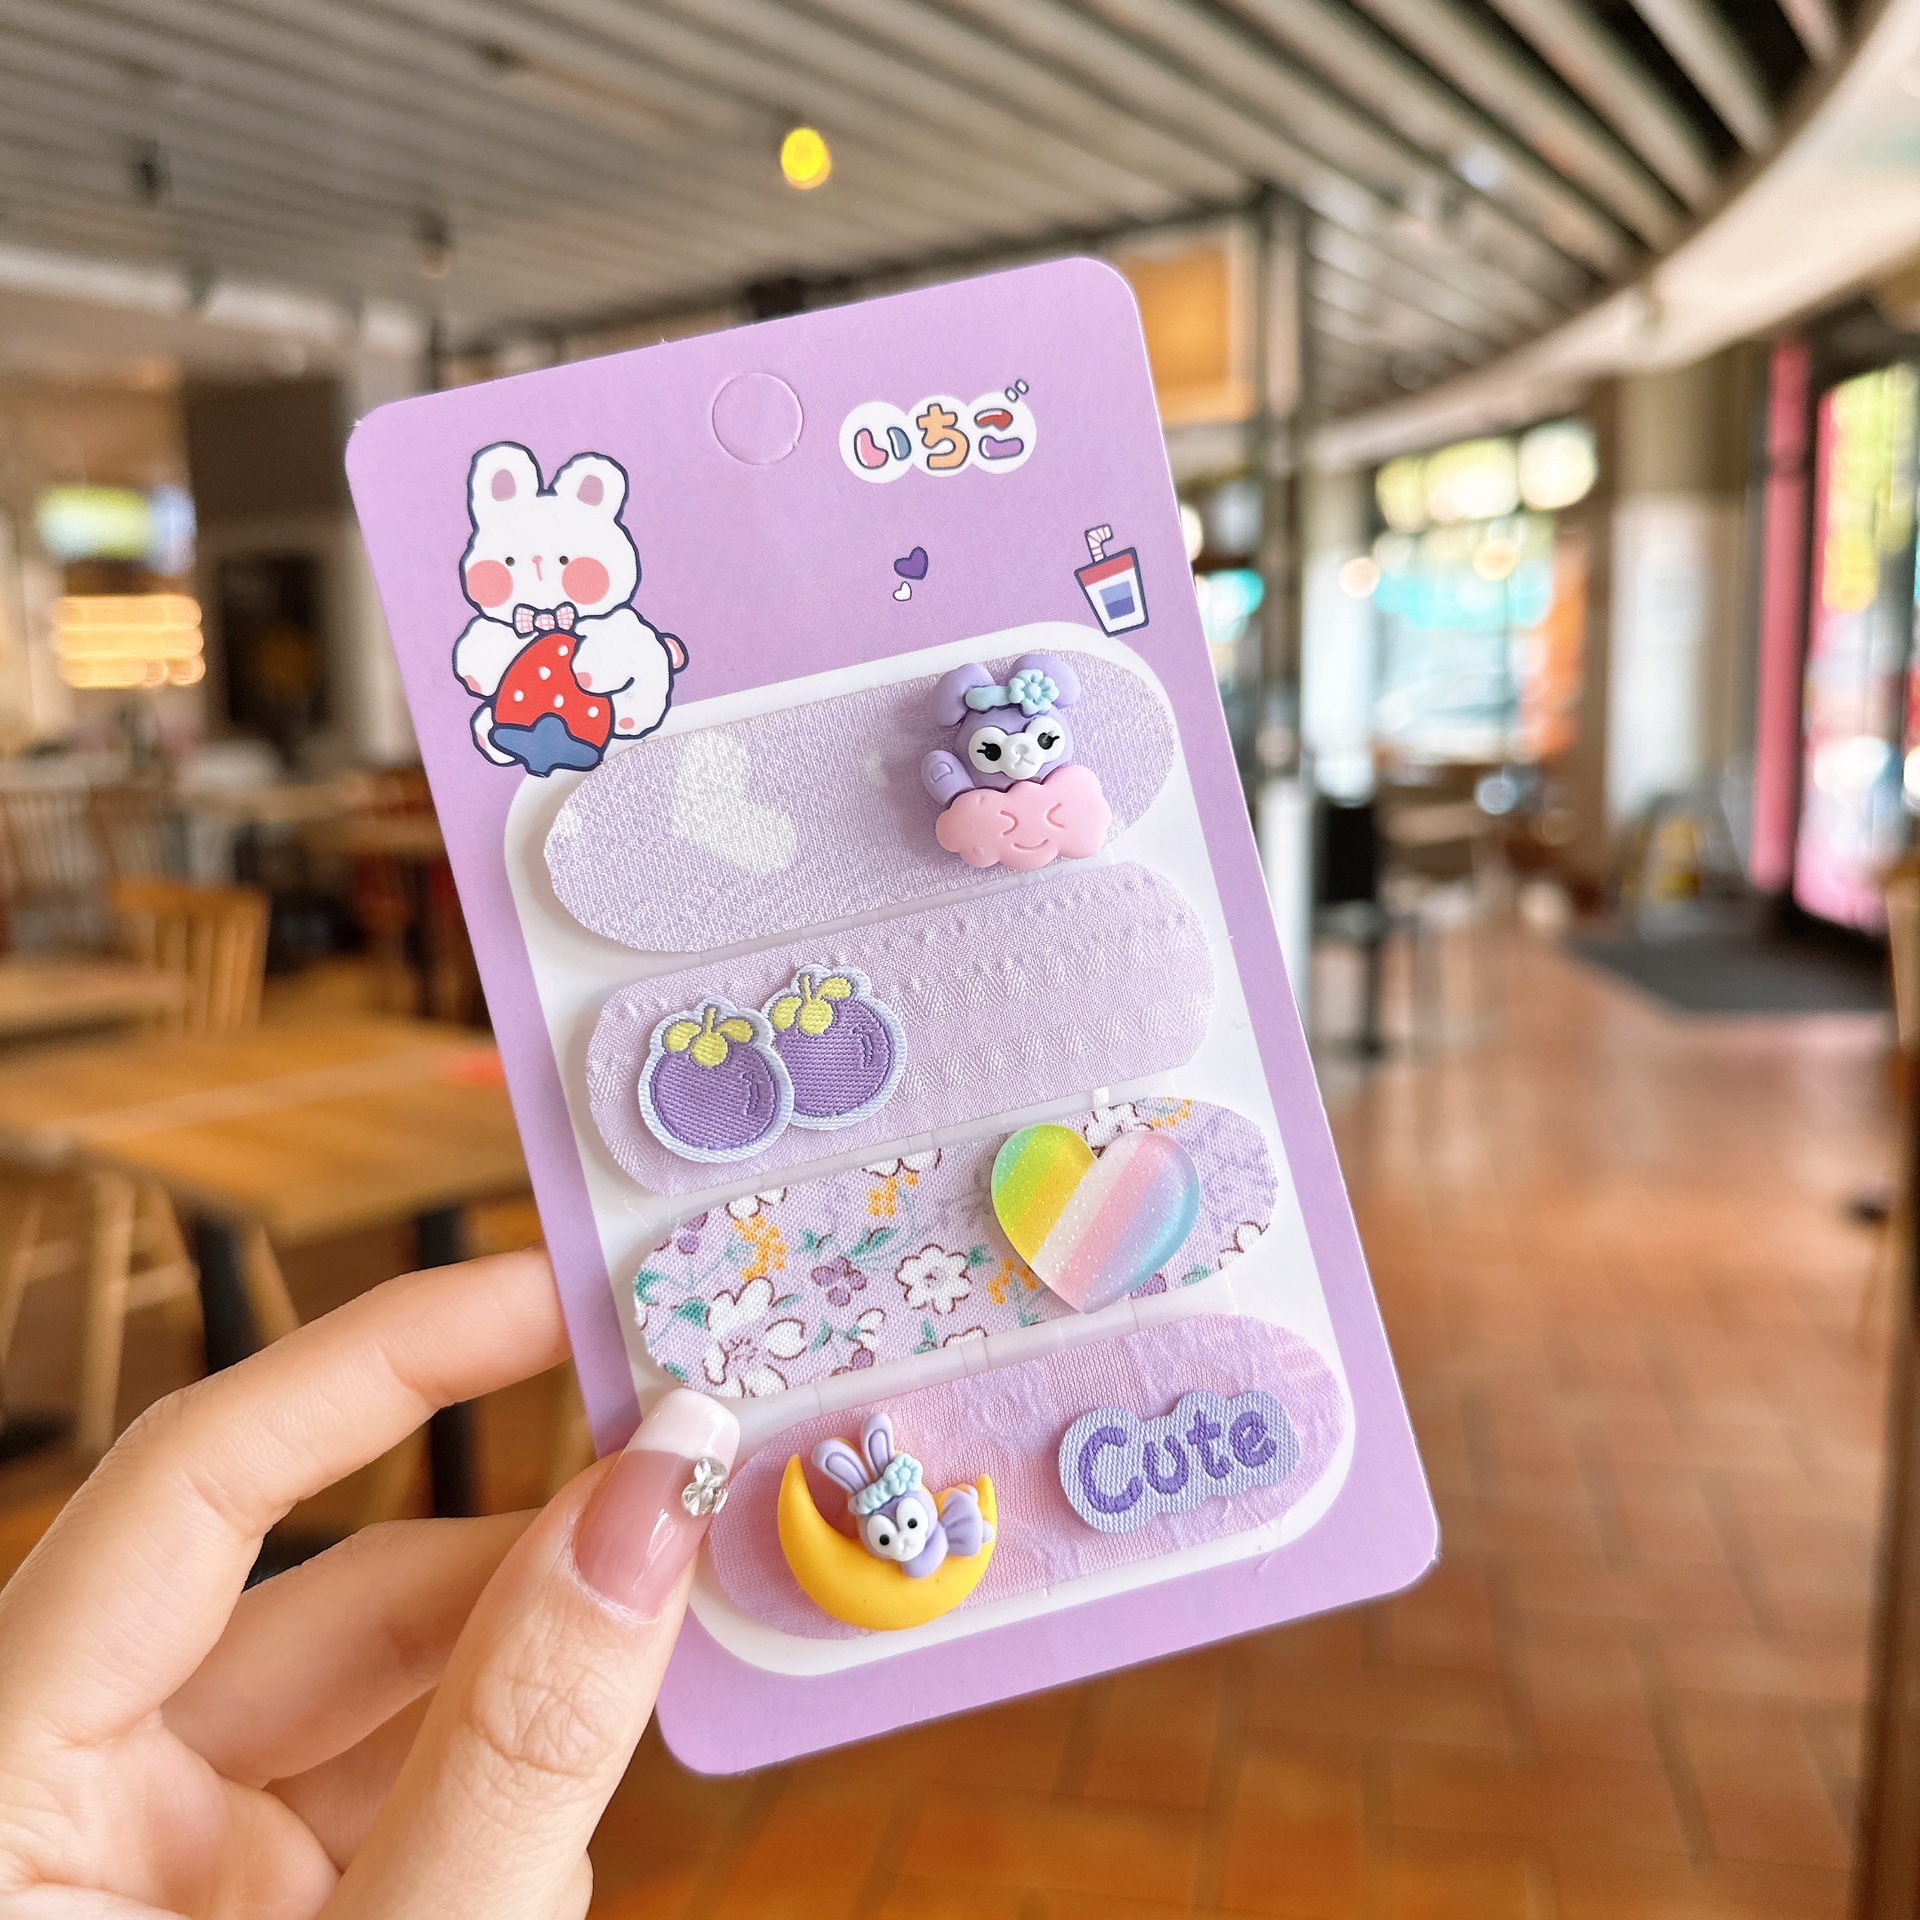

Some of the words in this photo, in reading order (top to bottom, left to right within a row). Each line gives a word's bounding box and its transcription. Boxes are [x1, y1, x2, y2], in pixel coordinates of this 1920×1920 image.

[853, 378, 1029, 470] いちご
[1078, 1410, 1277, 1514] Cute
